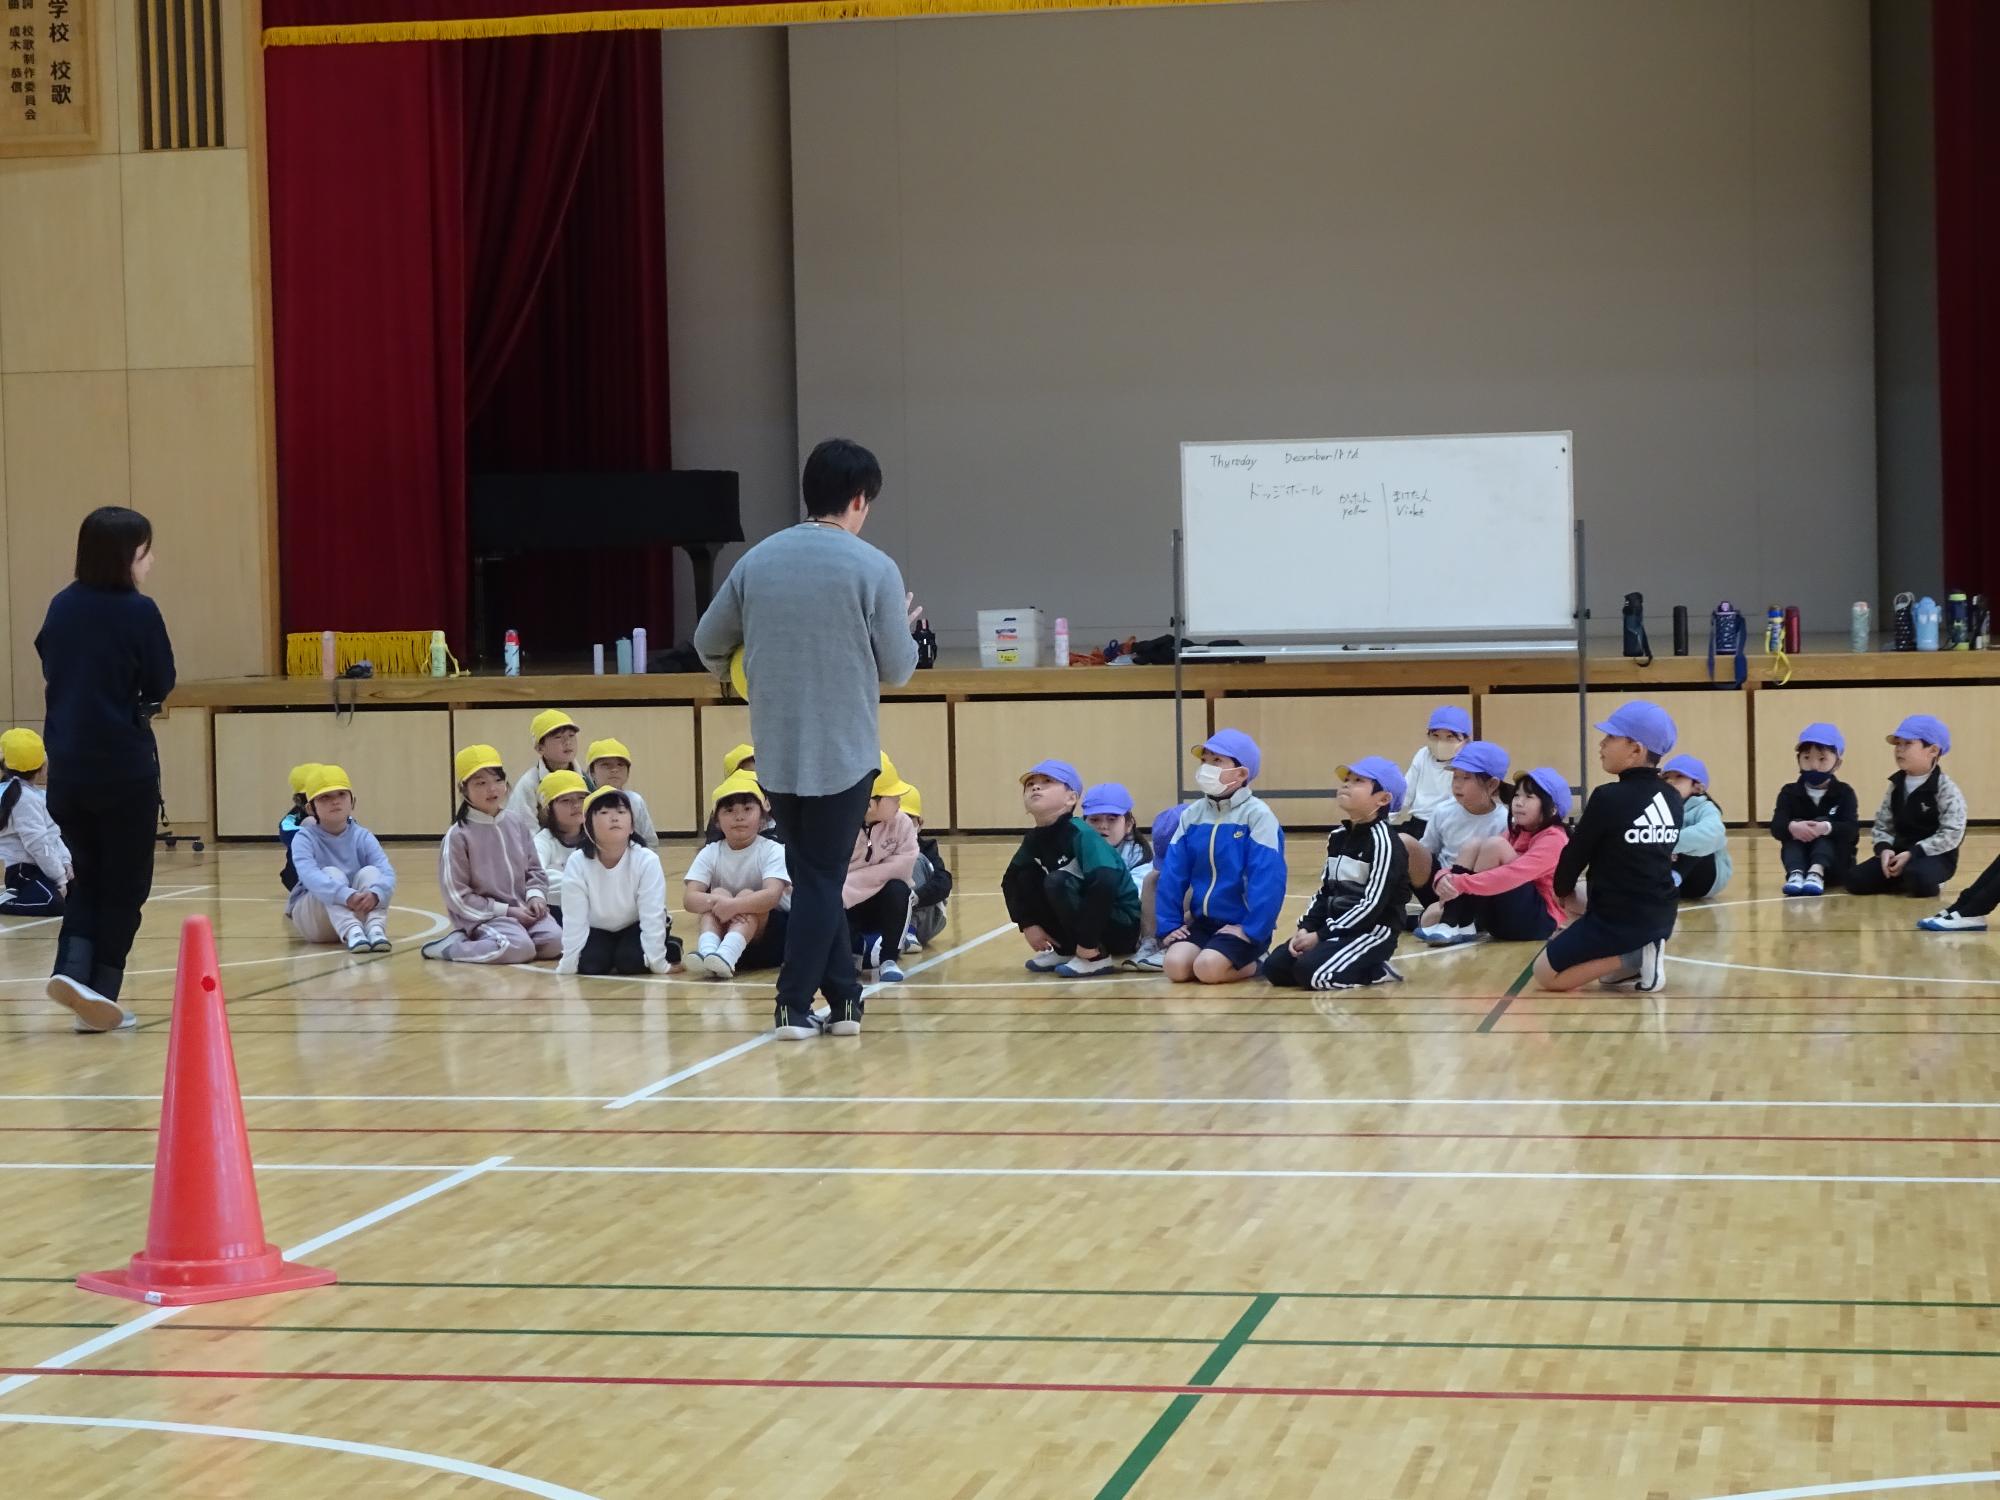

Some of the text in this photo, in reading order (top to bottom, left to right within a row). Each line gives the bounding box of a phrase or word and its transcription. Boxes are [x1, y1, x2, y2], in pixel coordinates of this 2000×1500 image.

[48, 0, 71, 105] 学校 校歌
[1210, 454, 1258, 471] Thursday
[1285, 449, 1333, 464] December
[1250, 482, 1323, 500] ドッジボール
[1624, 825, 1679, 843] adidas
